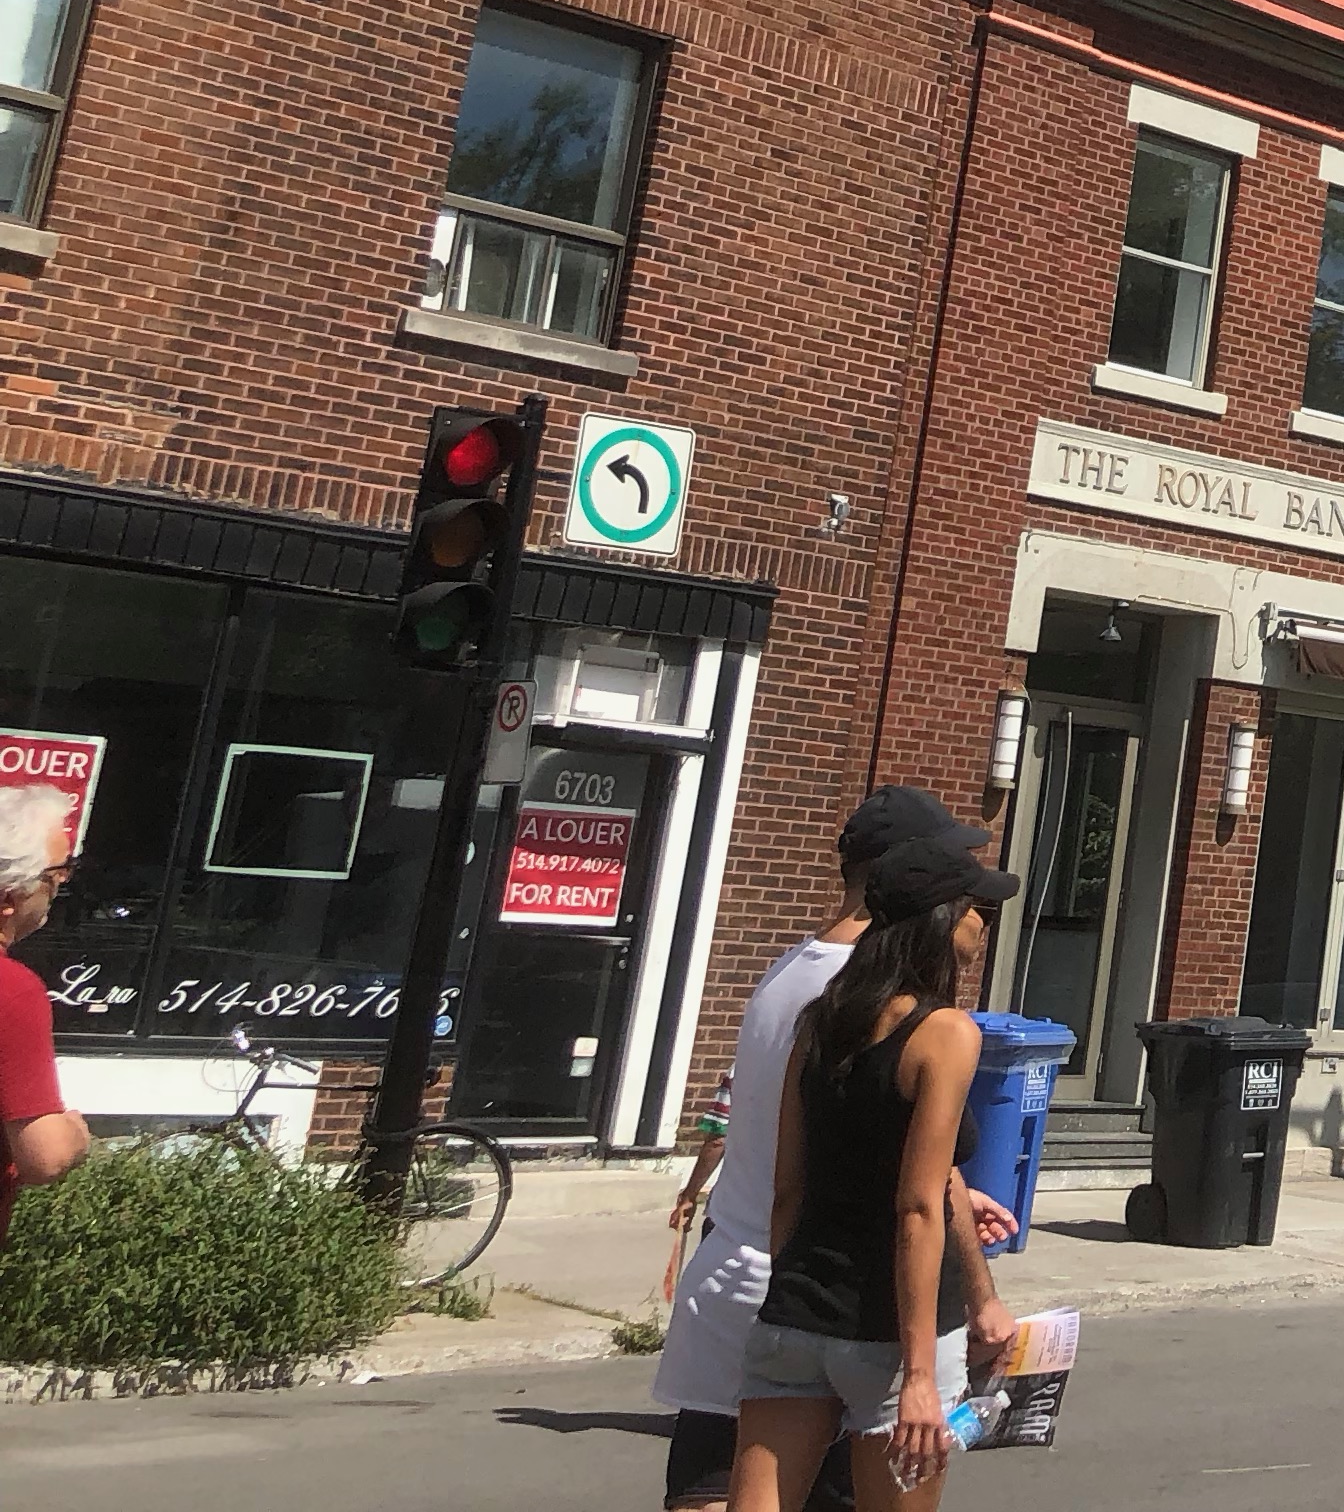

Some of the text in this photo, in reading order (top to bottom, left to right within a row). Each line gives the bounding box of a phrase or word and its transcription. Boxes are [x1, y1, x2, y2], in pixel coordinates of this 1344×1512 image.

[1057, 442, 1130, 495] THE
[1153, 463, 1259, 521] ROYAL
[555, 769, 616, 804] 6703
[520, 817, 626, 846] A LOUER
[515, 851, 621, 875] 514.917.4072
[508, 882, 616, 909] FOR RENT
[1248, 1062, 1278, 1078] RCI
